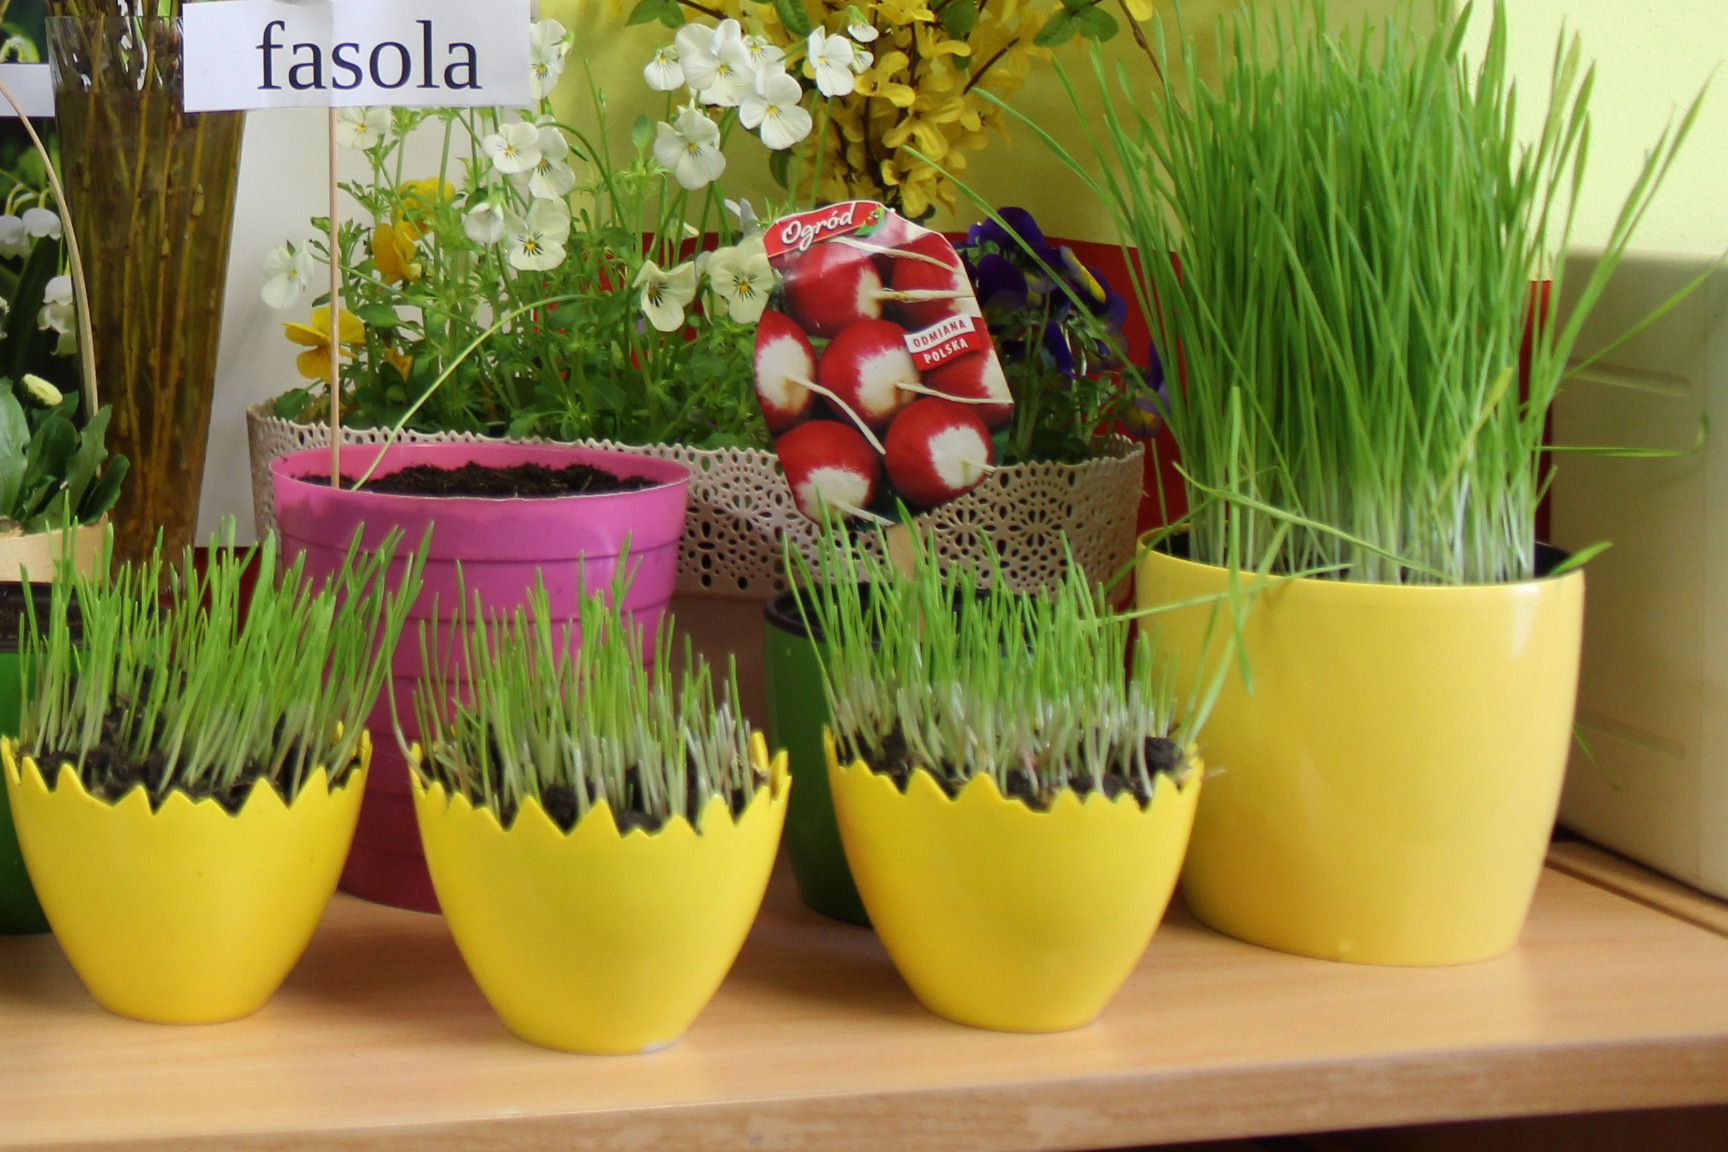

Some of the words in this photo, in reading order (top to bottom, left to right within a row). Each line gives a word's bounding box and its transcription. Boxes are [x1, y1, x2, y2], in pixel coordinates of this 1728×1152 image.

[256, 19, 482, 90] fasola
[781, 209, 854, 250] Ogród
[912, 319, 967, 348] ODMIANA
[924, 338, 969, 365] POLSKA
